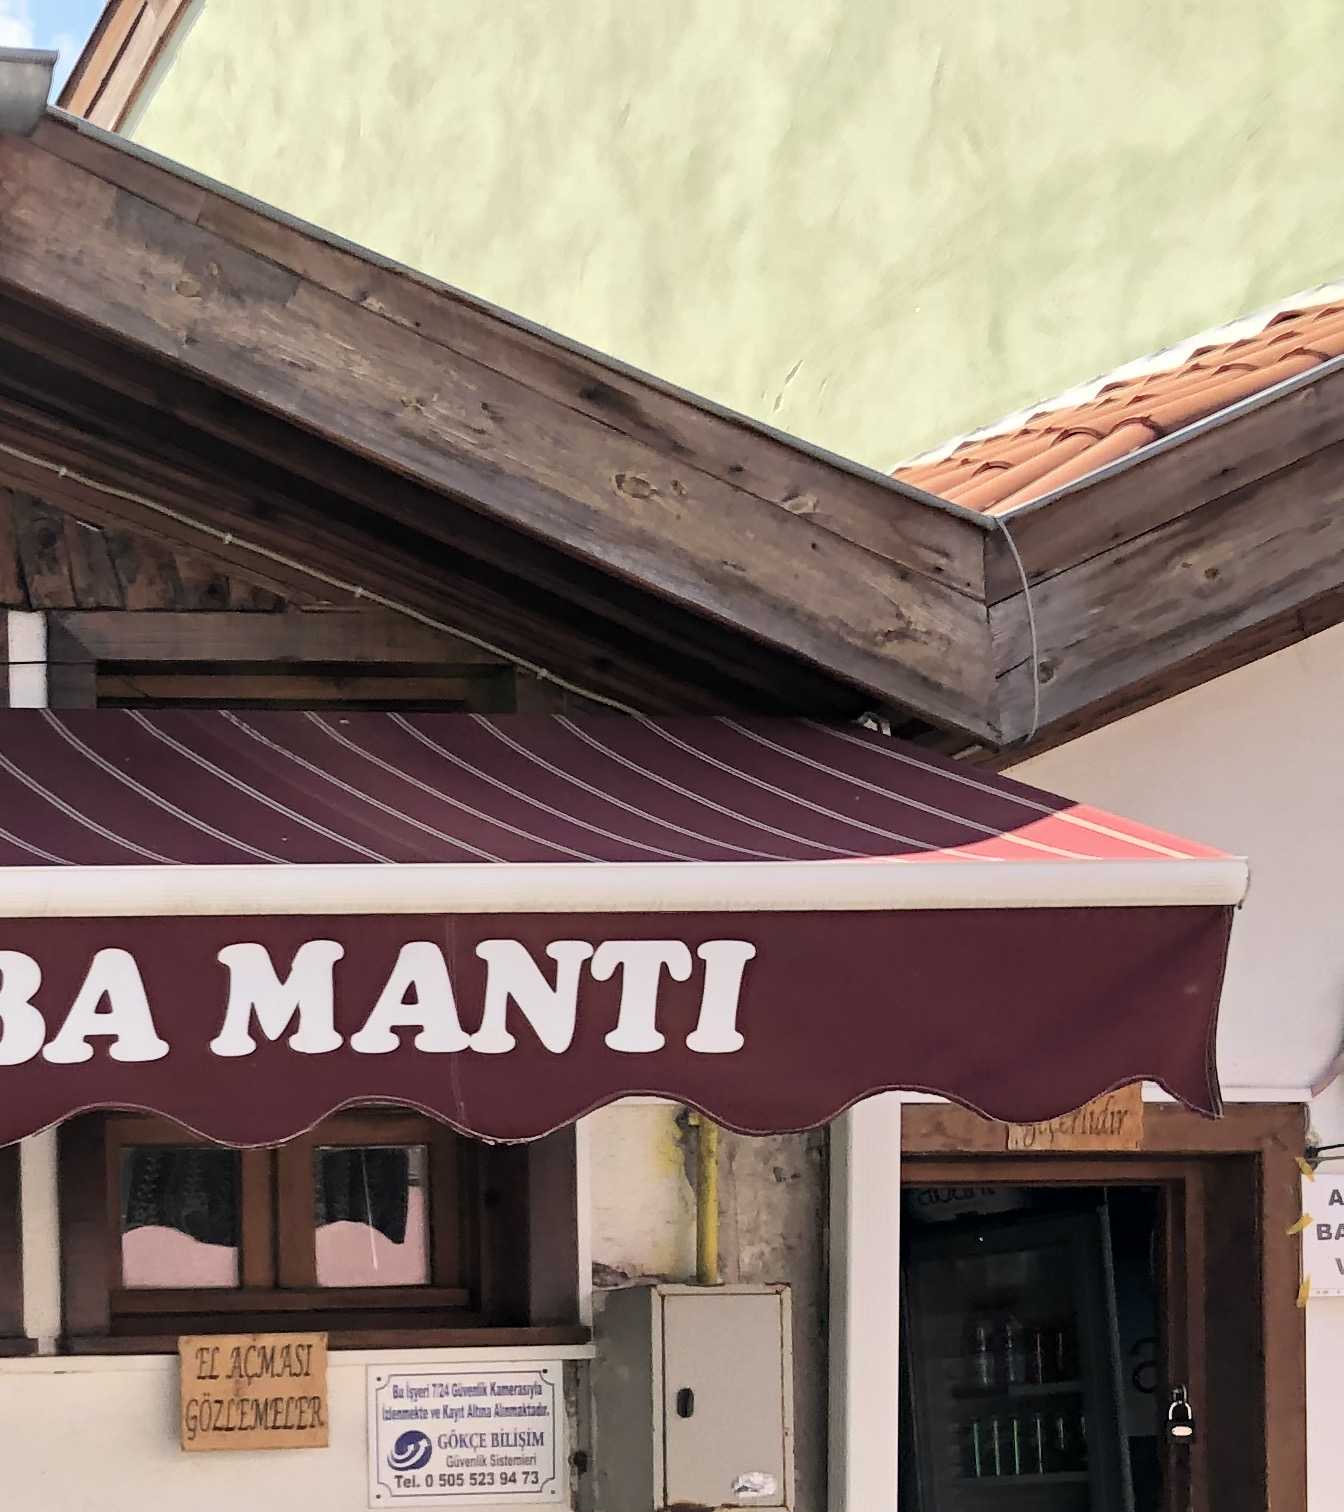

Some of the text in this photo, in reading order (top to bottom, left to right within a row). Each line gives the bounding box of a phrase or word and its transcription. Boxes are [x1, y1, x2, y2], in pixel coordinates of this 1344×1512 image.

[210, 939, 756, 1057] MANTI
[195, 1343, 314, 1386] EL AÇMASI
[184, 1391, 325, 1441] GÖZLEMELER
[437, 1427, 545, 1452] GÖKÇE BİLİŞİM
[394, 1470, 540, 1488] Tel. 0 505 523 94 73
